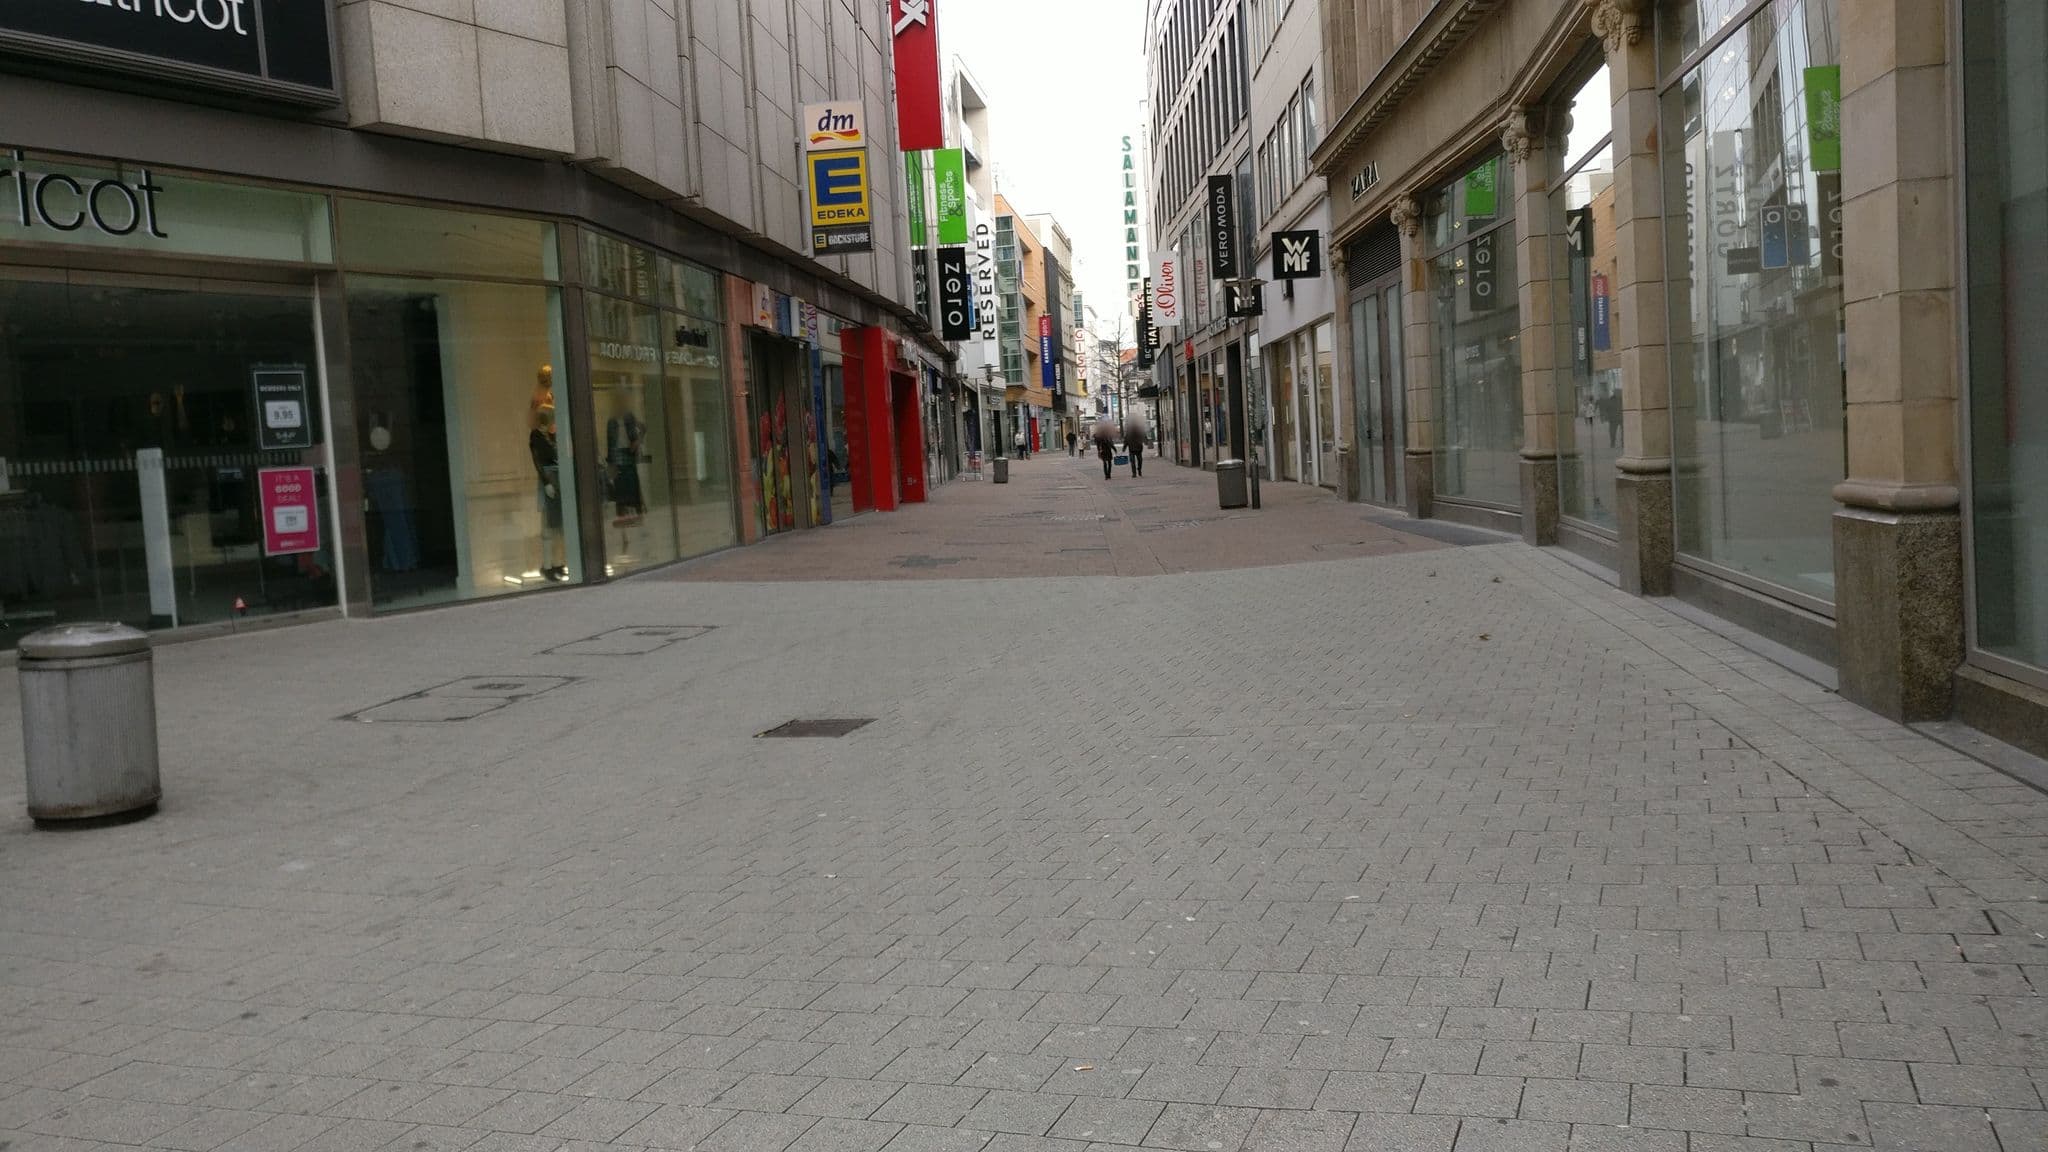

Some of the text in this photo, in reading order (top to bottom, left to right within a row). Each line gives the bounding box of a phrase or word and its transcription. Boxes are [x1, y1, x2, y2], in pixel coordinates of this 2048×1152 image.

[818, 109, 854, 131] dm
[1351, 160, 1381, 201] ZARA
[817, 208, 865, 220] EDEKA
[1215, 186, 1229, 268] VERO MODA
[828, 232, 869, 246] BACKSTUBE
[944, 262, 964, 327] zero
[976, 222, 996, 341] RESERVED
[1155, 260, 1177, 318] s.Oliver
[1075, 329, 1087, 377] GISY
[275, 484, 302, 494] GOOD
